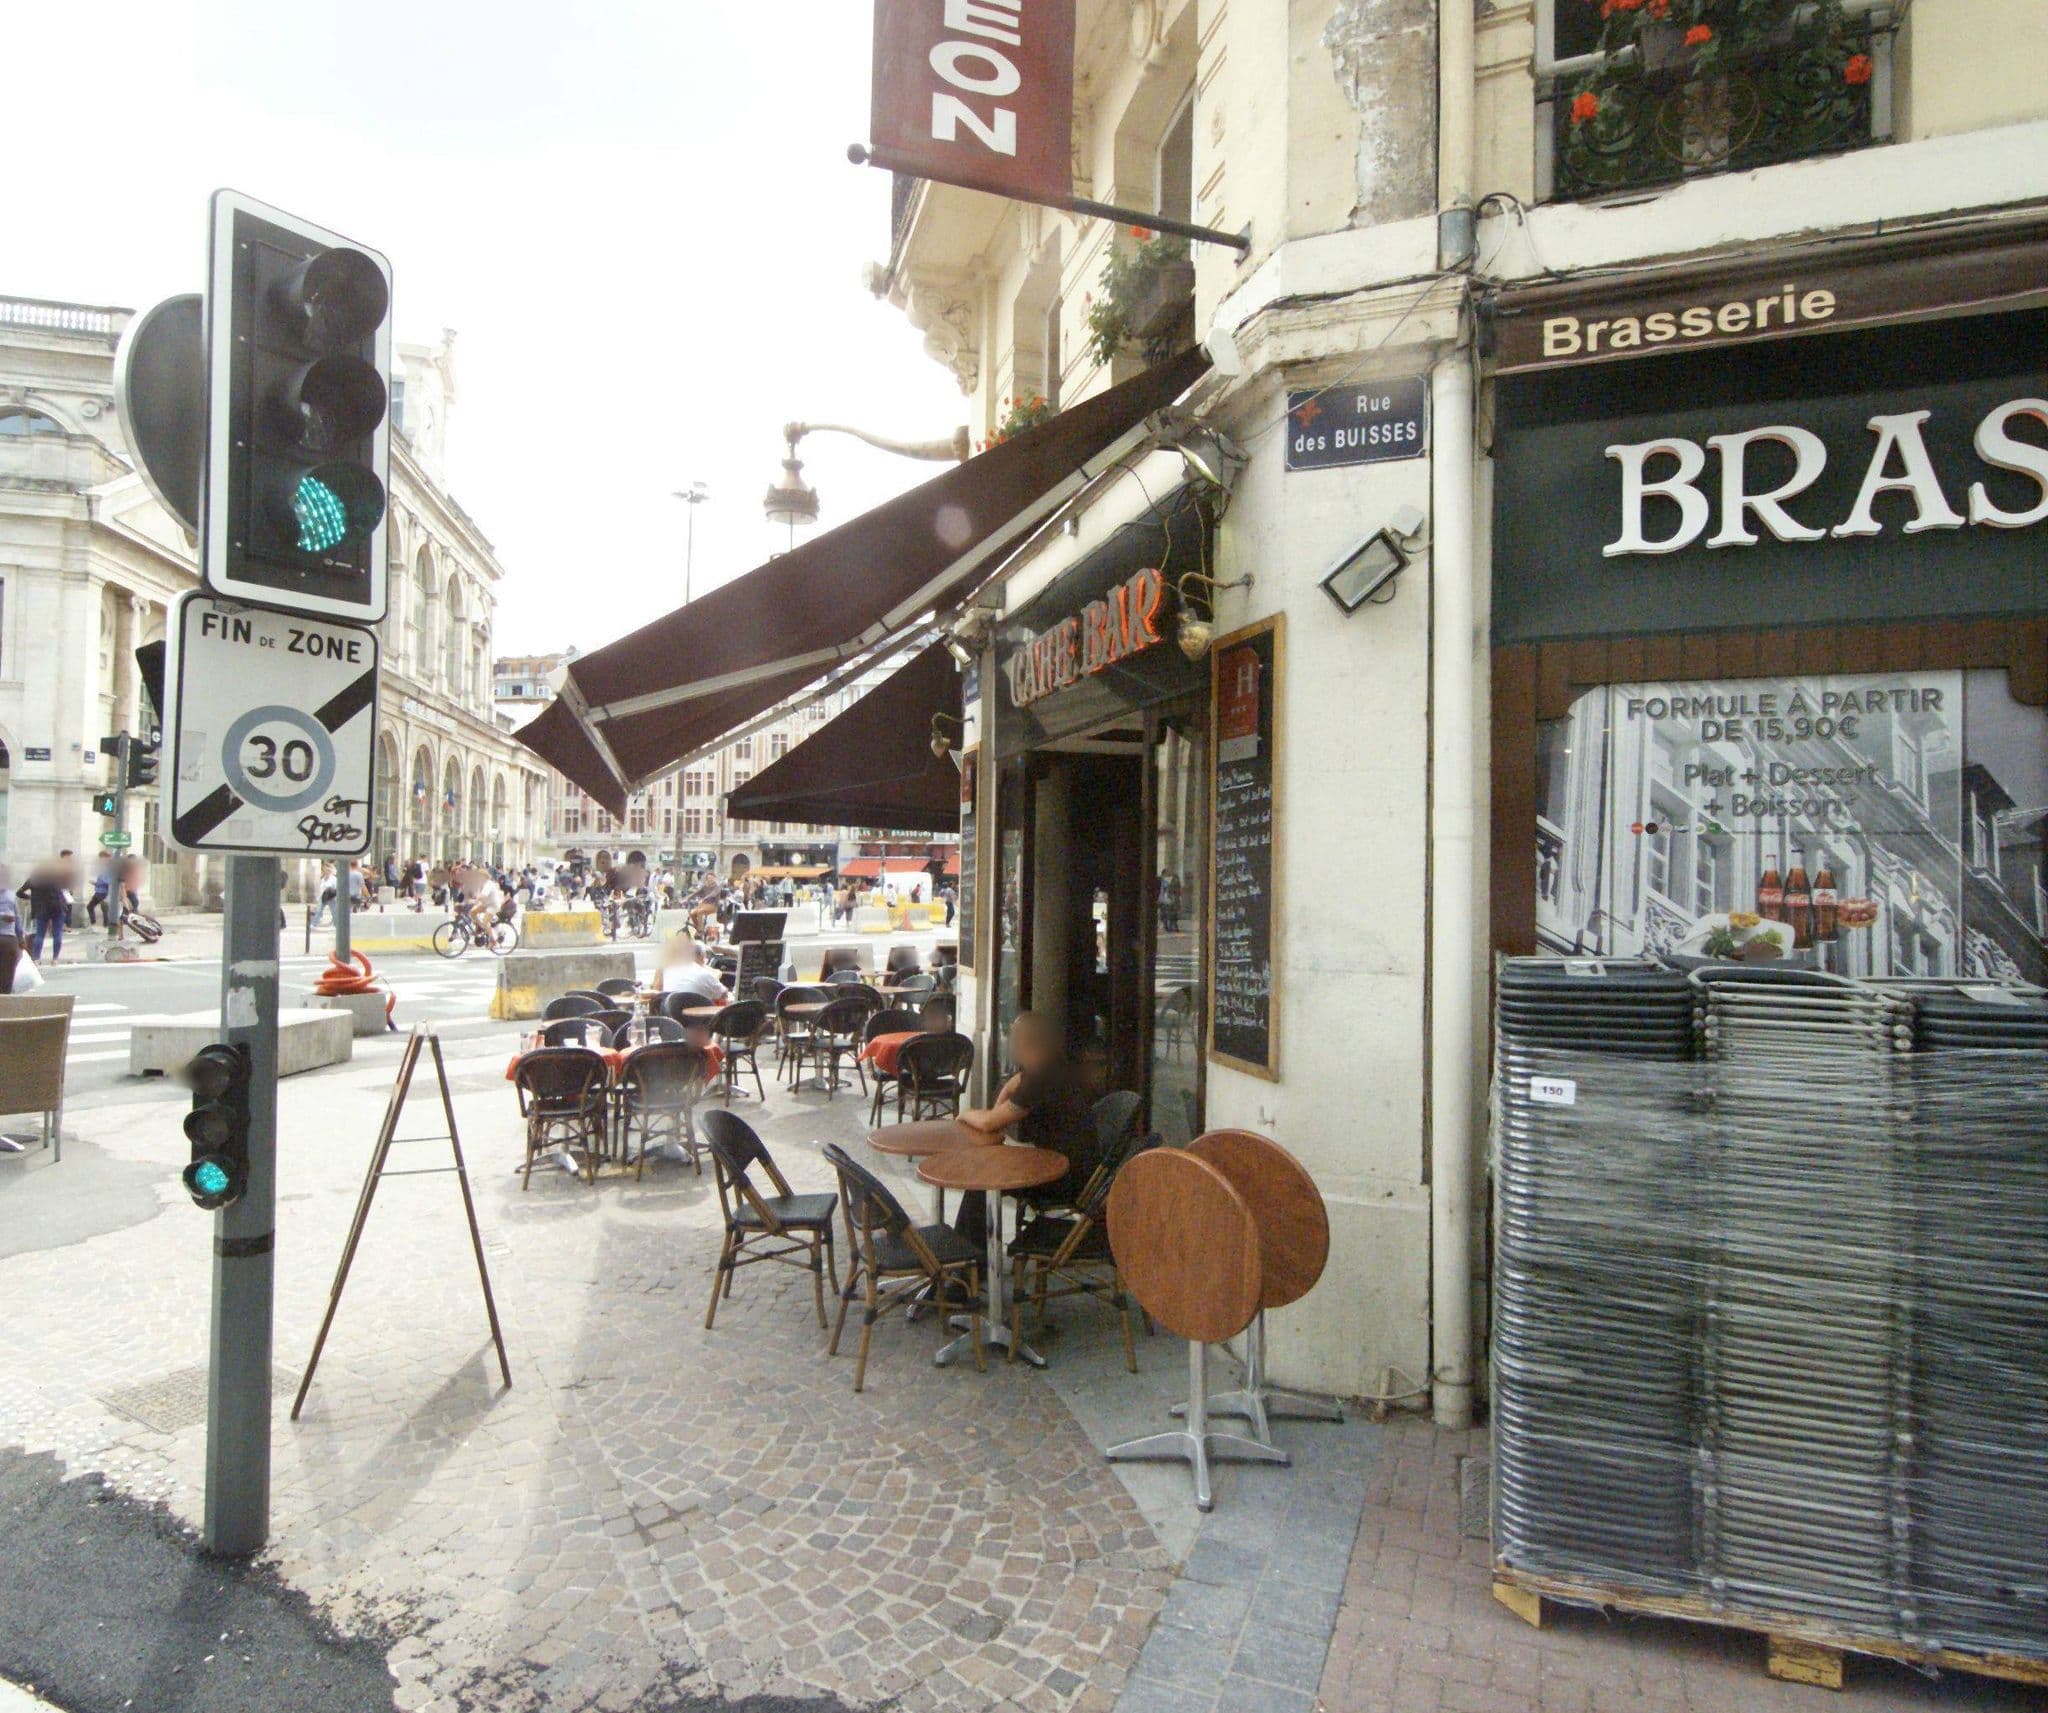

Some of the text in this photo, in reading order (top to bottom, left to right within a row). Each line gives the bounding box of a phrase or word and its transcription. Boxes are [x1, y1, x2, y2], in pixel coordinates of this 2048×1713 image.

[1543, 284, 1837, 357] Brasserie
[1357, 395, 1391, 413] Rue
[1295, 421, 1417, 452] des BUISSES
[1602, 398, 2048, 557] BRAS
[202, 612, 362, 664] FIN DE ZONE
[1080, 567, 1164, 676] BAR
[1627, 693, 1778, 721] FORMULE
[1820, 686, 1945, 715] PARTIR
[1701, 715, 1861, 745] DE 15,90€
[246, 735, 314, 782] 30
[1684, 762, 1879, 787] Plat + Dessert
[1703, 798, 1724, 817] +
